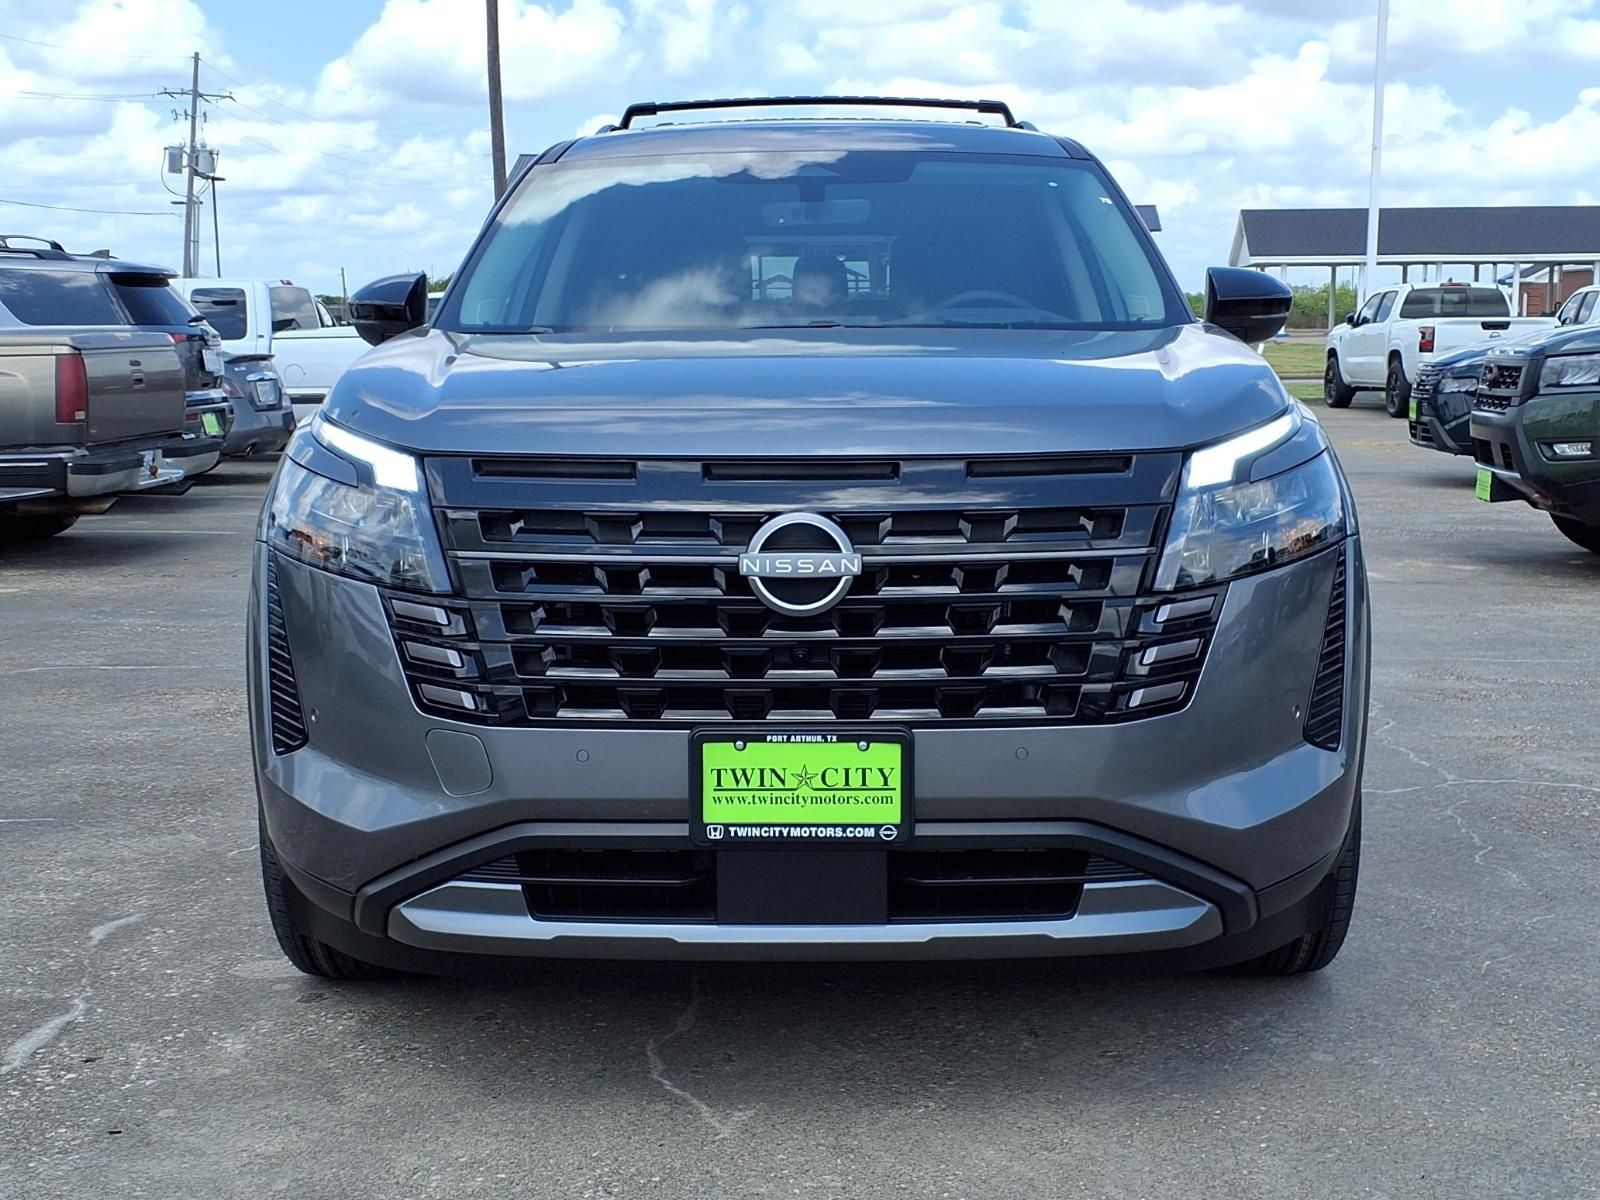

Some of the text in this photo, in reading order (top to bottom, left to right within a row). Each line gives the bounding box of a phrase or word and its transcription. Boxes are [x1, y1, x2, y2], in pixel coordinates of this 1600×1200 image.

[743, 558, 858, 573] NISSAN
[766, 735, 788, 743] PORT
[826, 735, 837, 743] TX
[710, 767, 895, 788] TWIN CITY
[712, 792, 893, 808] www.twincitymotors.com
[728, 826, 875, 838] TWINCITYMOTORS.COM
